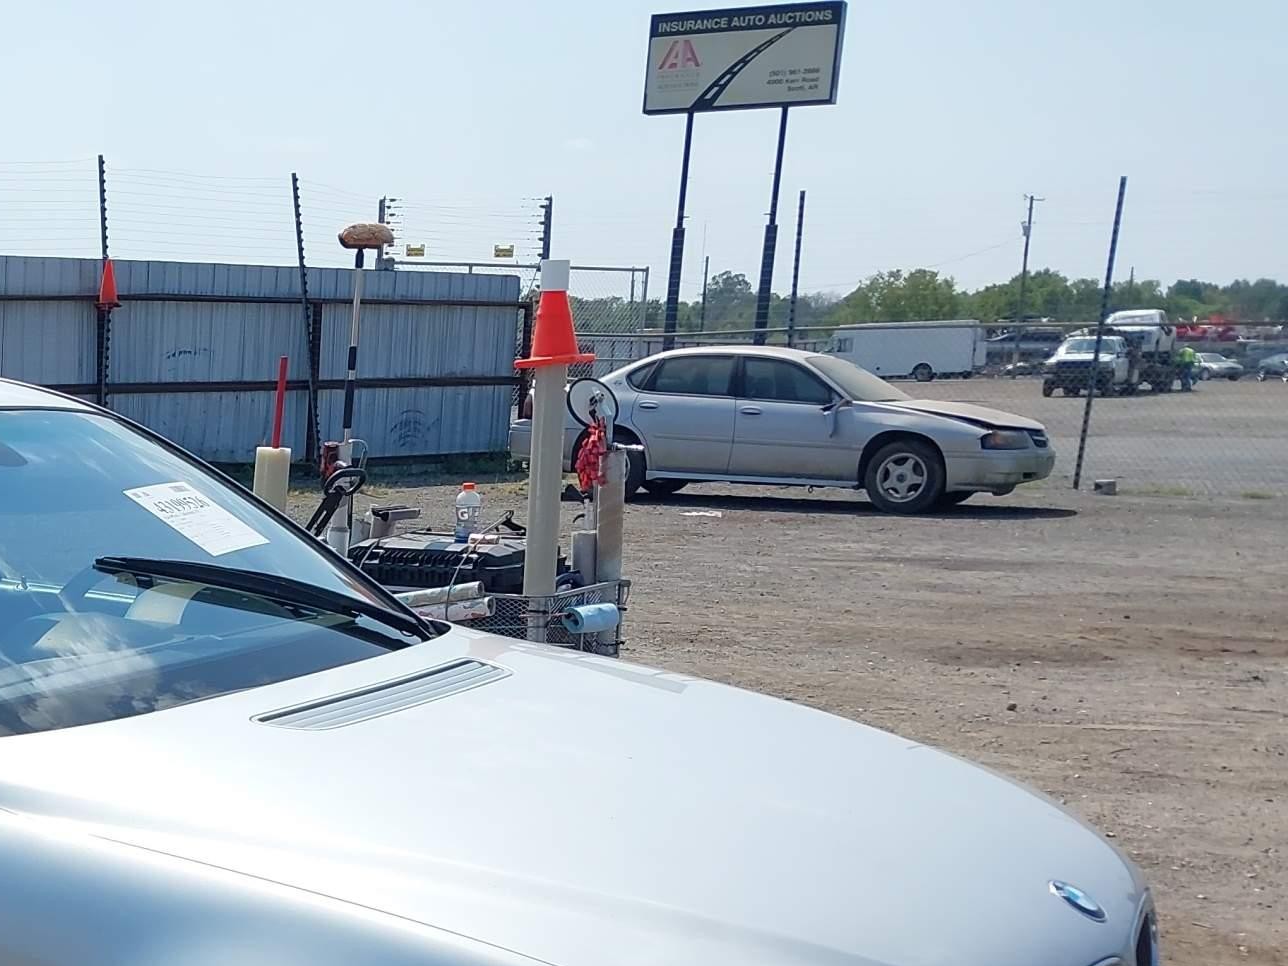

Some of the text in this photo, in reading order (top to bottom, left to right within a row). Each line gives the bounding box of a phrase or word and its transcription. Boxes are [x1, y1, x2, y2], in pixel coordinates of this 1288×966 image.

[658, 9, 833, 33] INSURANCE AUTO AUCTIONS
[152, 496, 210, 514] 43199526
